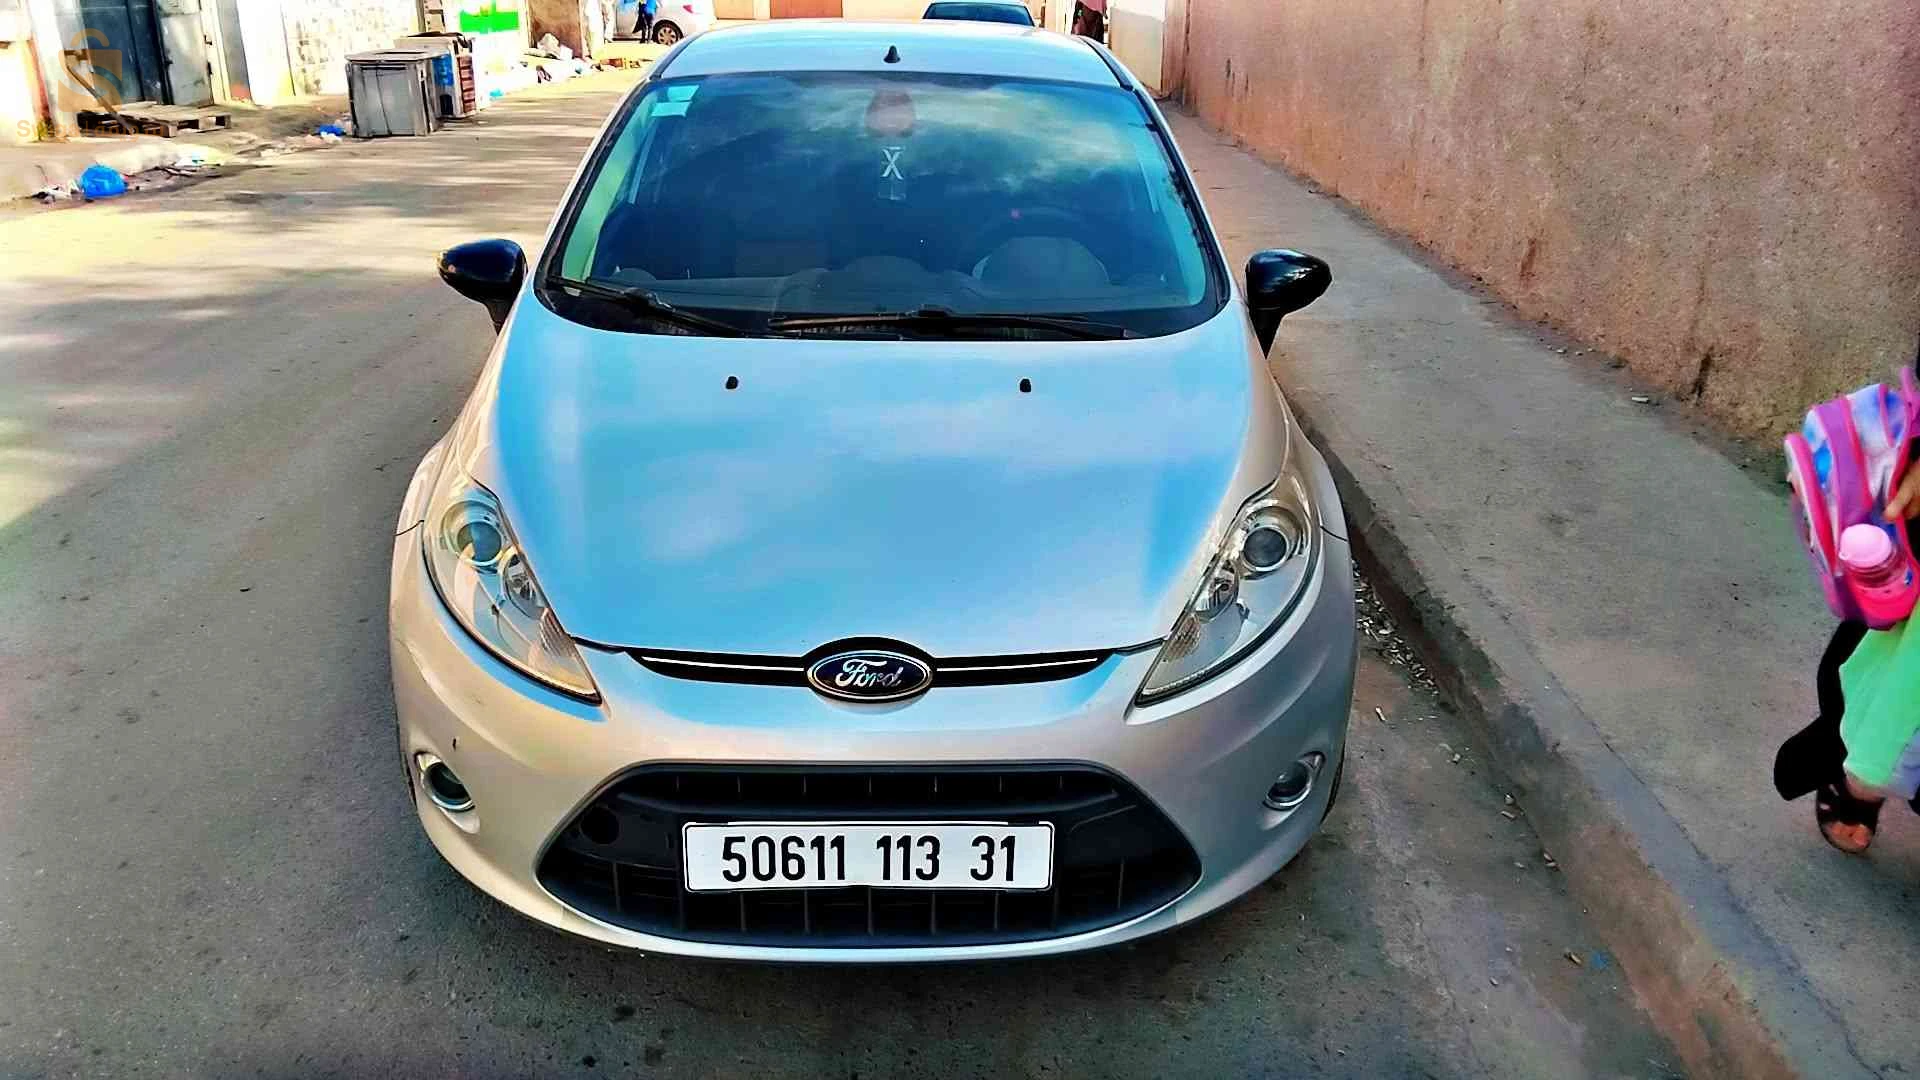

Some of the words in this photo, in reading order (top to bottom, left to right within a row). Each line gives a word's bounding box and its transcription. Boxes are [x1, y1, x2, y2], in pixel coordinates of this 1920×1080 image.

[835, 658, 904, 688] Ford
[721, 834, 847, 882] 50611
[876, 834, 941, 882] 113
[969, 834, 1016, 882] 31
